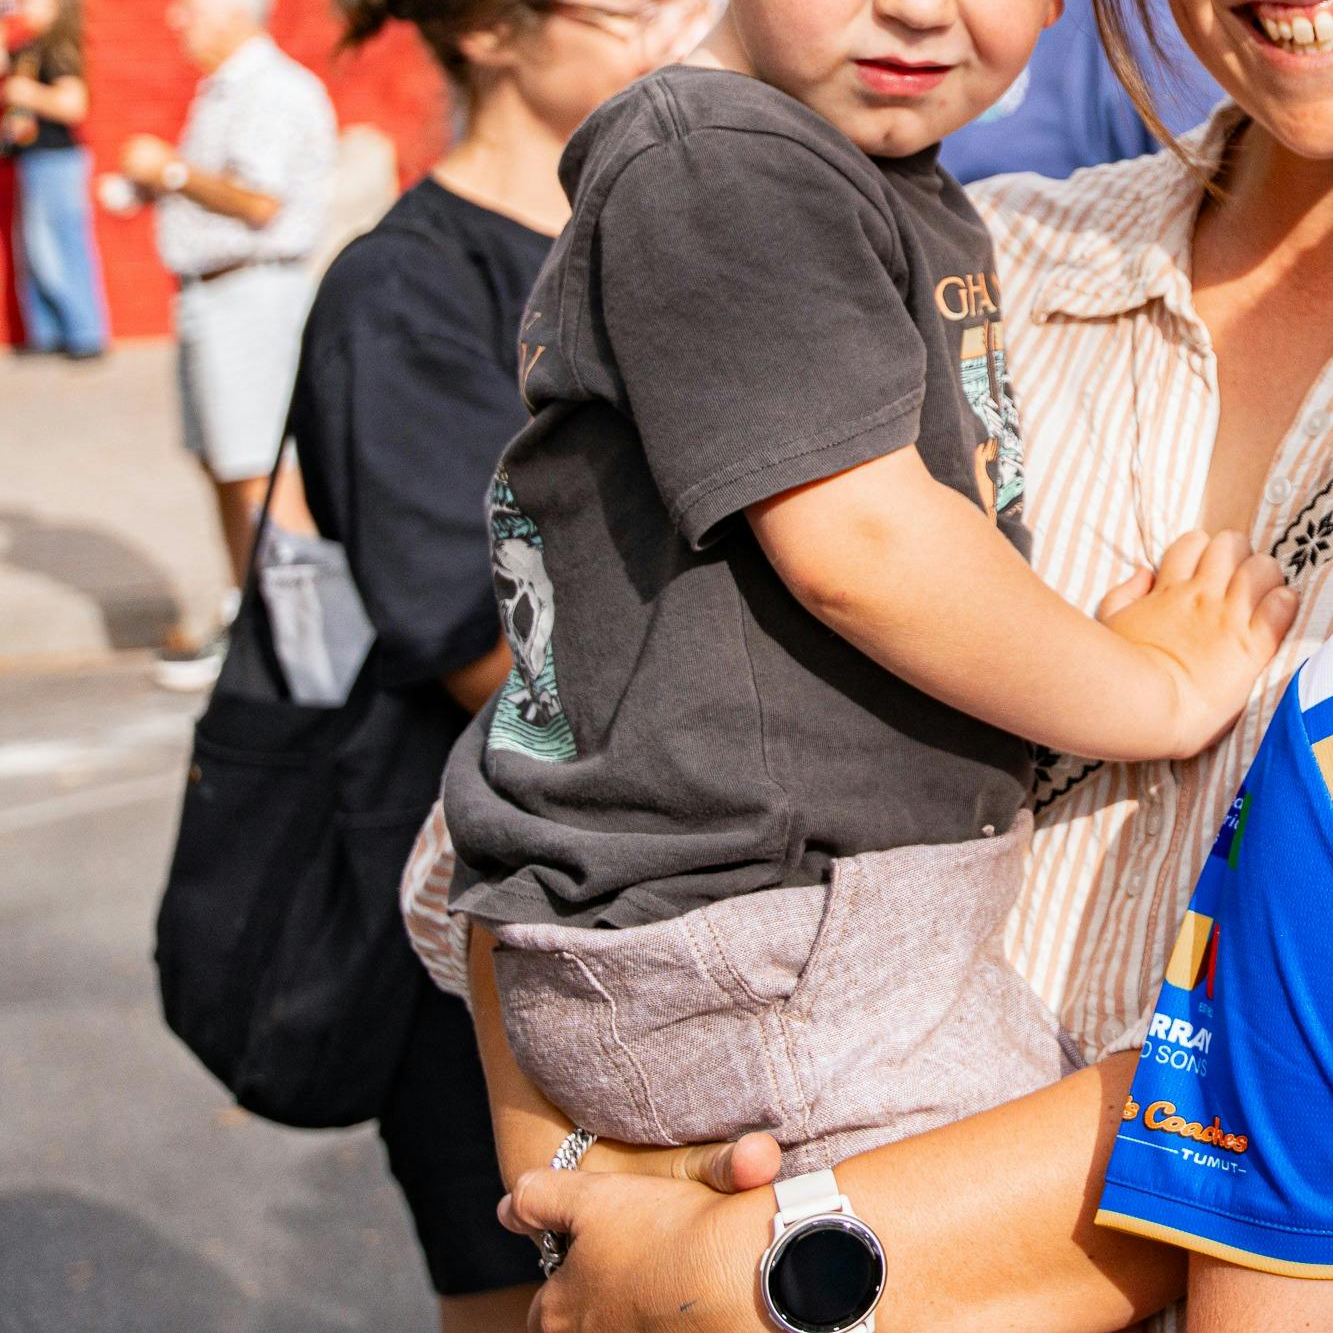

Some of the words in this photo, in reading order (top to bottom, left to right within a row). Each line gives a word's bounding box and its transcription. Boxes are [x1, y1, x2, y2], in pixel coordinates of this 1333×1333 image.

[1148, 1012, 1213, 1055] RRAY
[1155, 1045, 1208, 1077] SONS
[1144, 1100, 1249, 1154] Coaches
[1181, 1147, 1239, 1173] TUMUT
